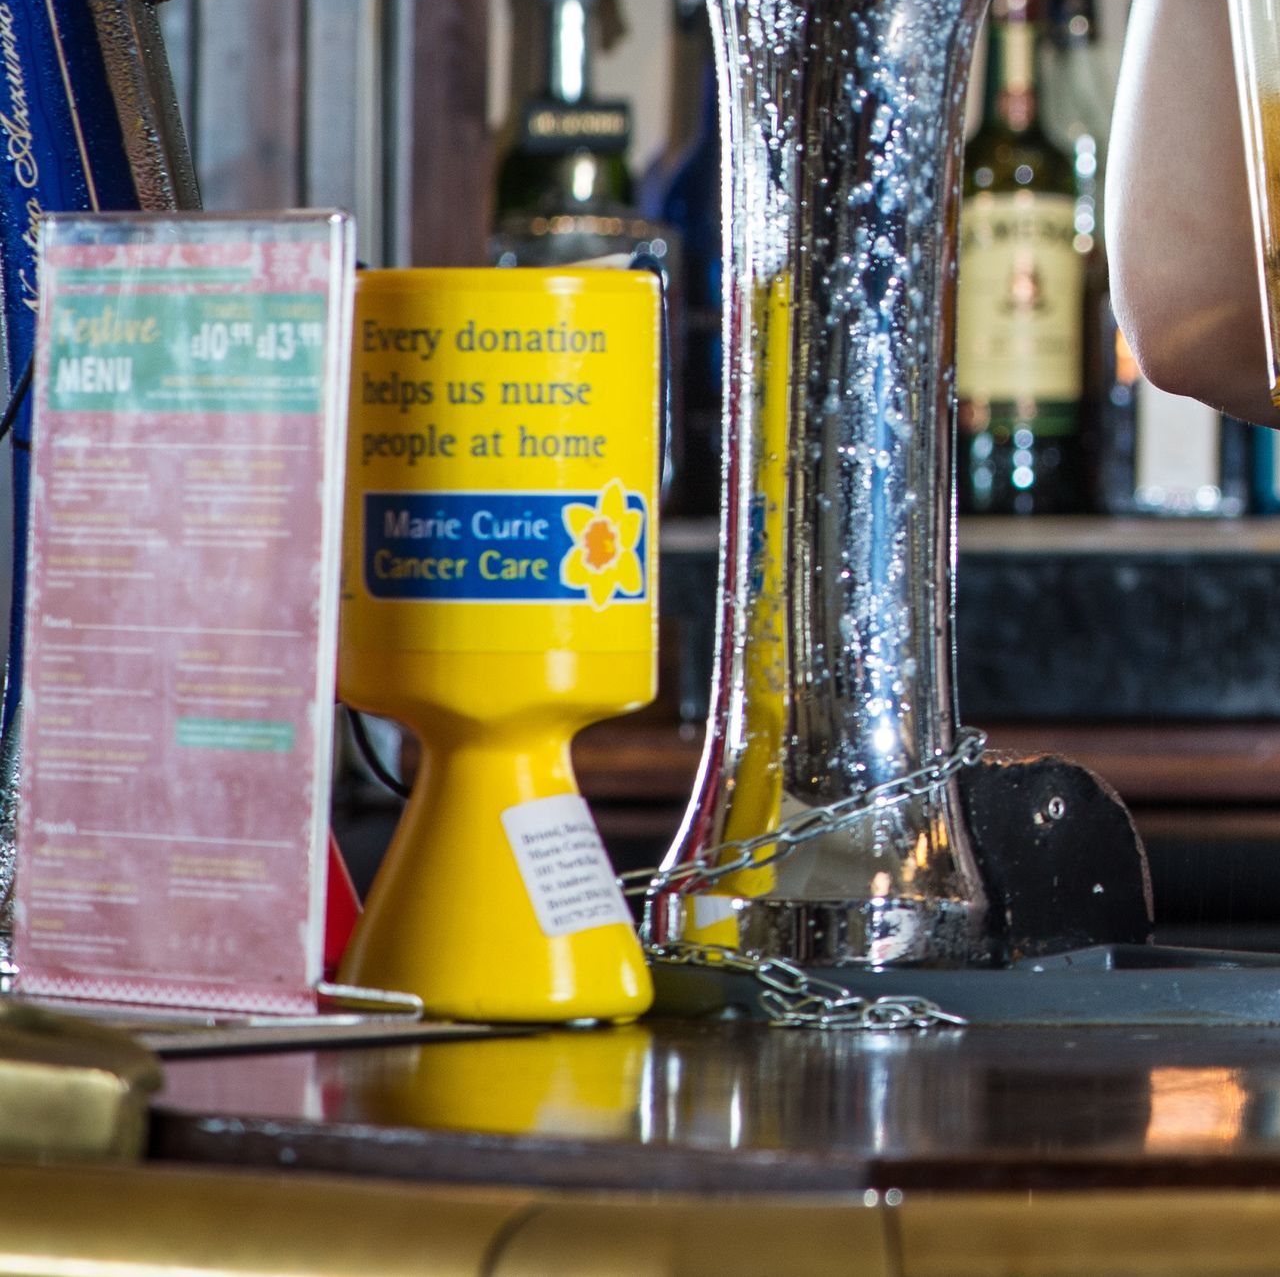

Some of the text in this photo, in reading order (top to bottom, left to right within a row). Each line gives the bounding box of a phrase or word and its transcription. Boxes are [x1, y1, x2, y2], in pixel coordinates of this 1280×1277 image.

[362, 320, 607, 361] Every donation
[55, 356, 134, 394] MENU
[362, 372, 592, 414] helps us nurse
[362, 424, 608, 467] people at home
[384, 509, 550, 541] Marie Curie
[373, 549, 549, 581] Cancer Care
